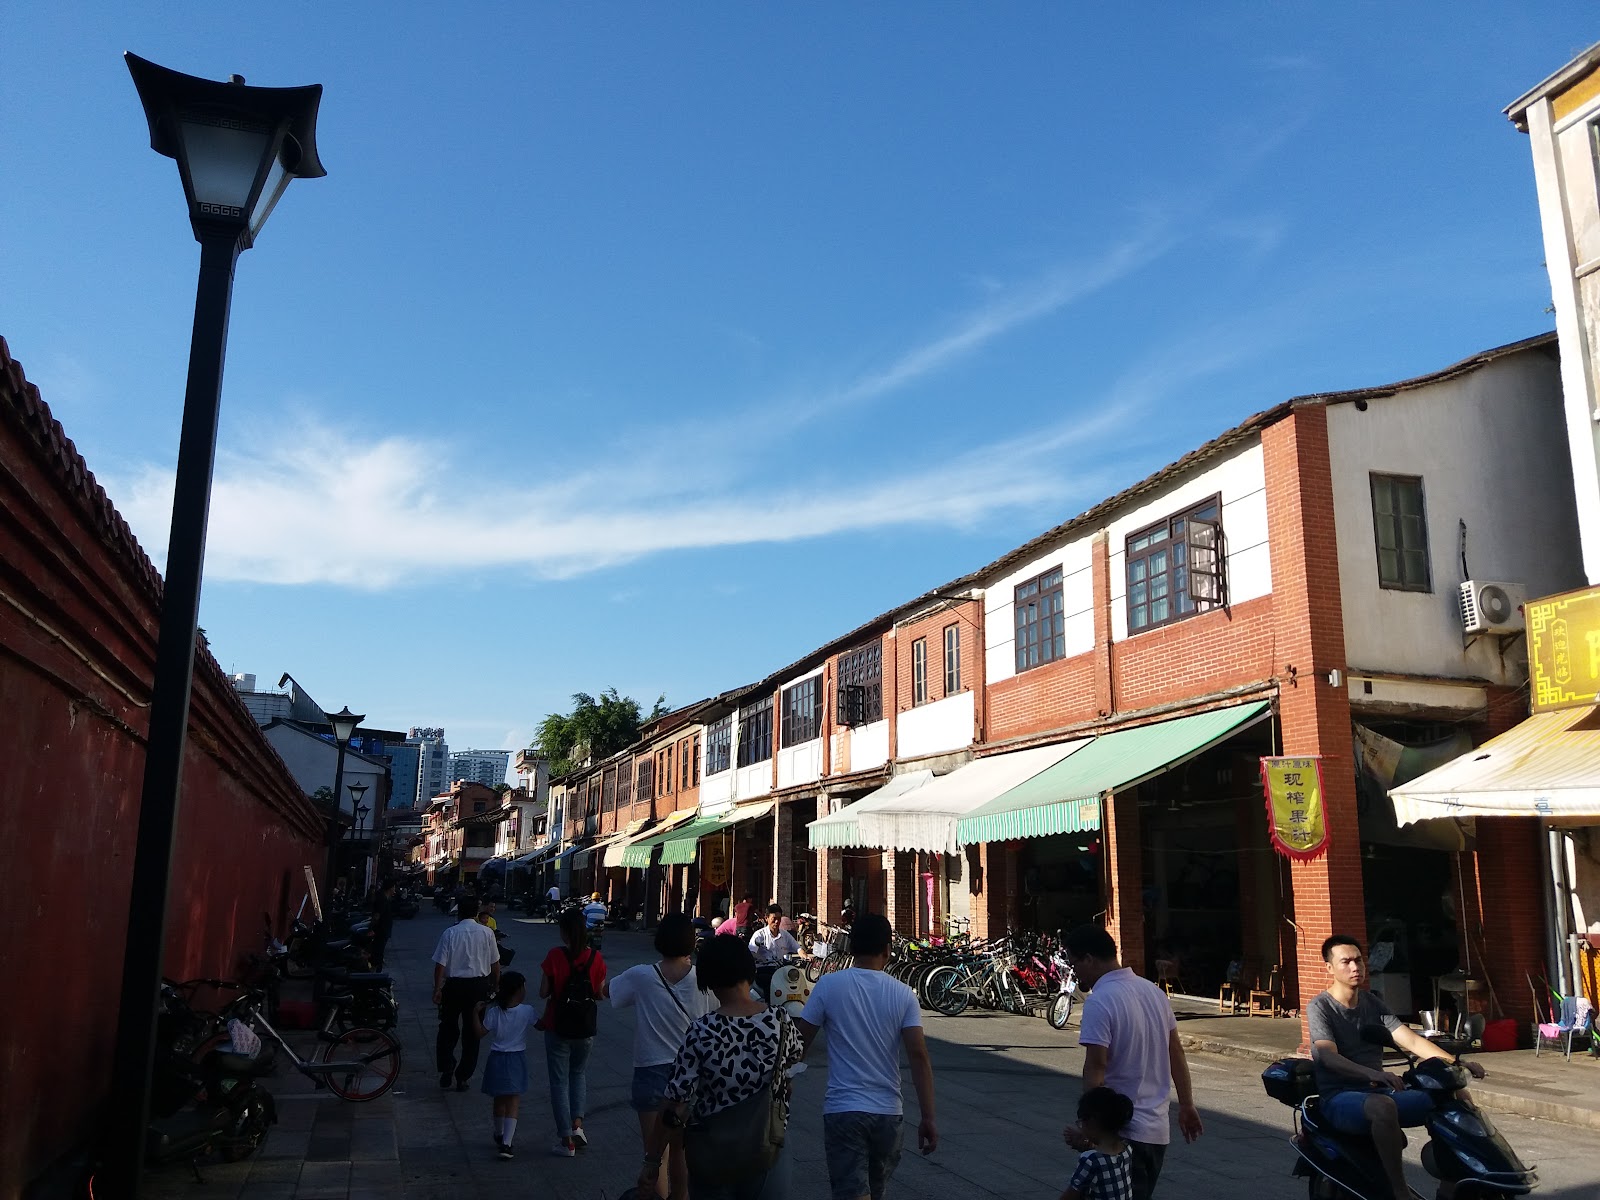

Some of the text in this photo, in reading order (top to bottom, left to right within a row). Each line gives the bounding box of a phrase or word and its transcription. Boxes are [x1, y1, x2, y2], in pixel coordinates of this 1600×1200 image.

[1554, 626, 1568, 677] 欢迎光临
[1284, 773, 1311, 842] 现榨果汁
